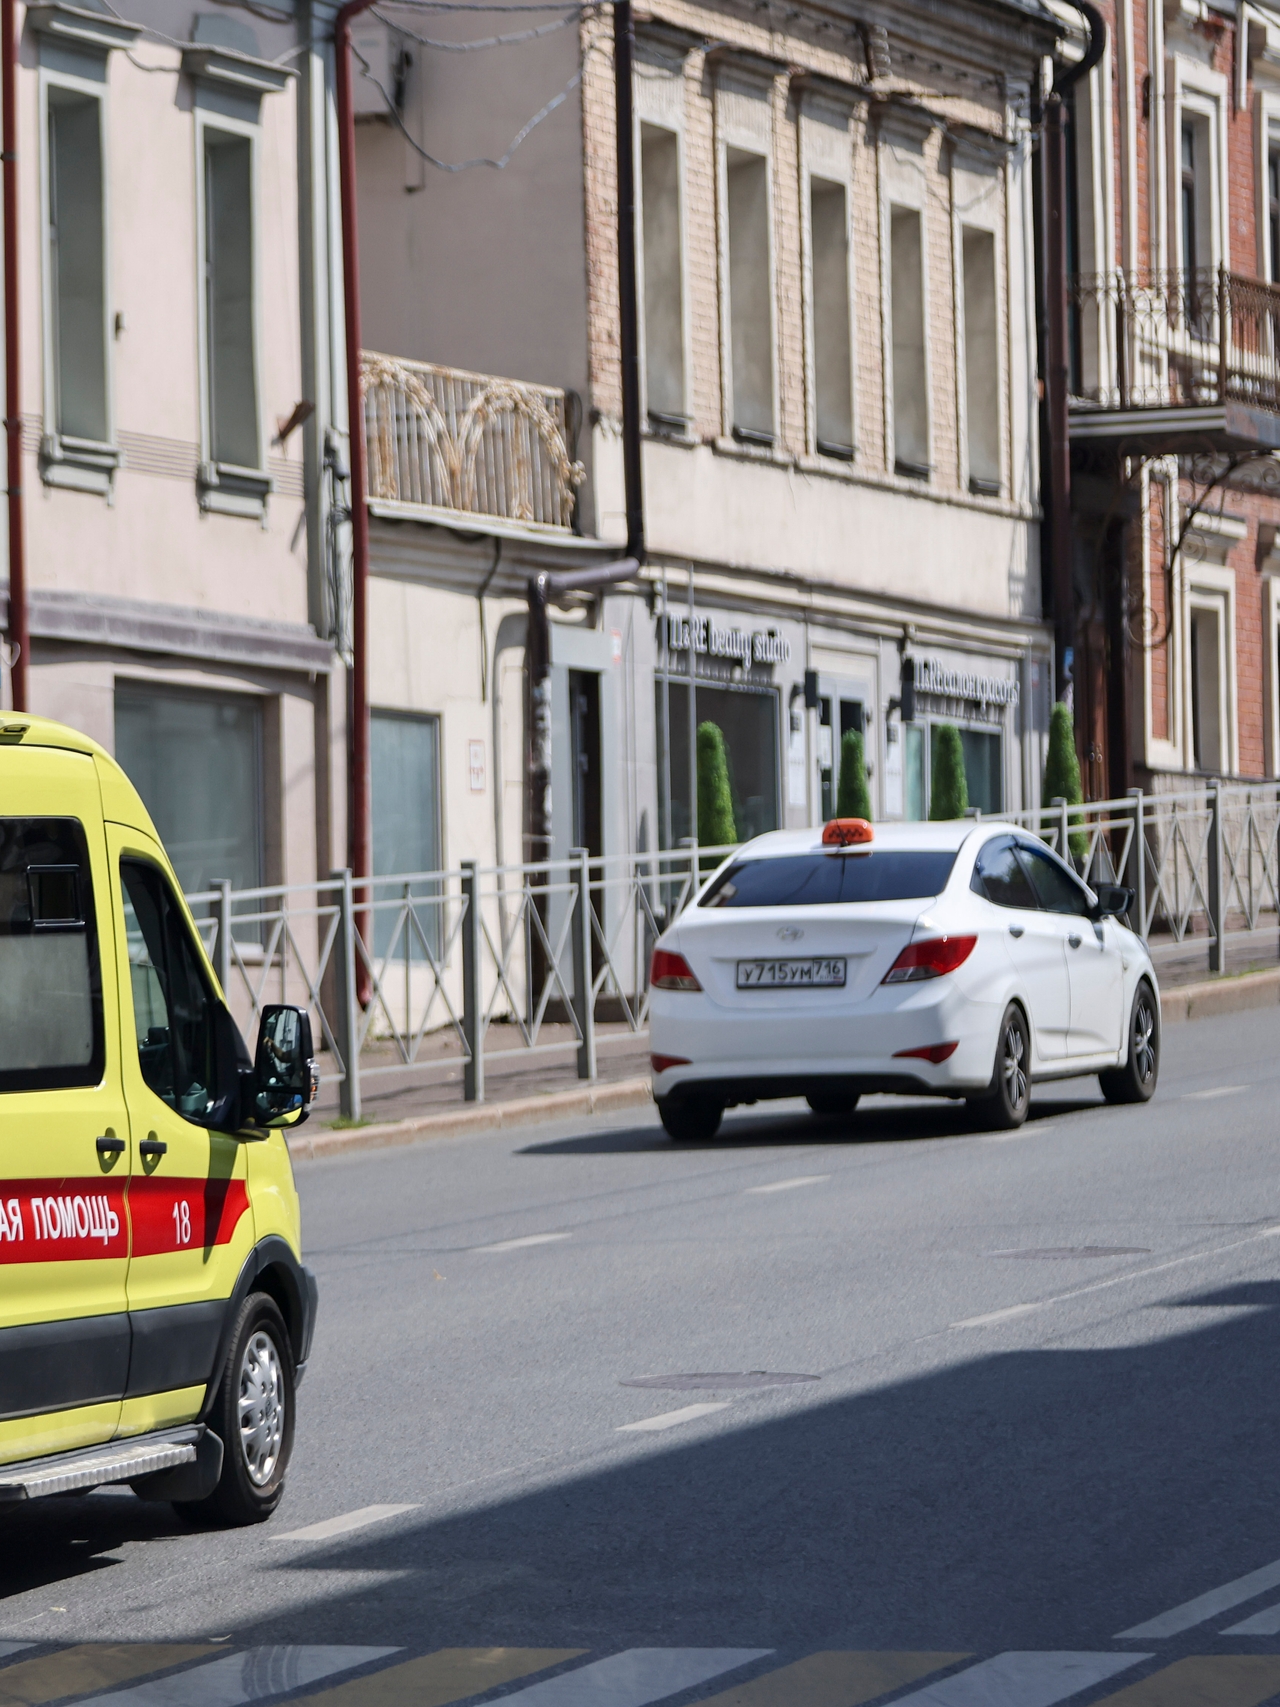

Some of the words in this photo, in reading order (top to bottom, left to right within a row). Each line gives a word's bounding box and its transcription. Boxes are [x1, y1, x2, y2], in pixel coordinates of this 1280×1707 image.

[708, 617, 752, 671] beauty
[753, 627, 791, 663] studio
[31, 1195, 119, 1246] ПОМОЩЬ
[172, 1201, 192, 1245] 18
